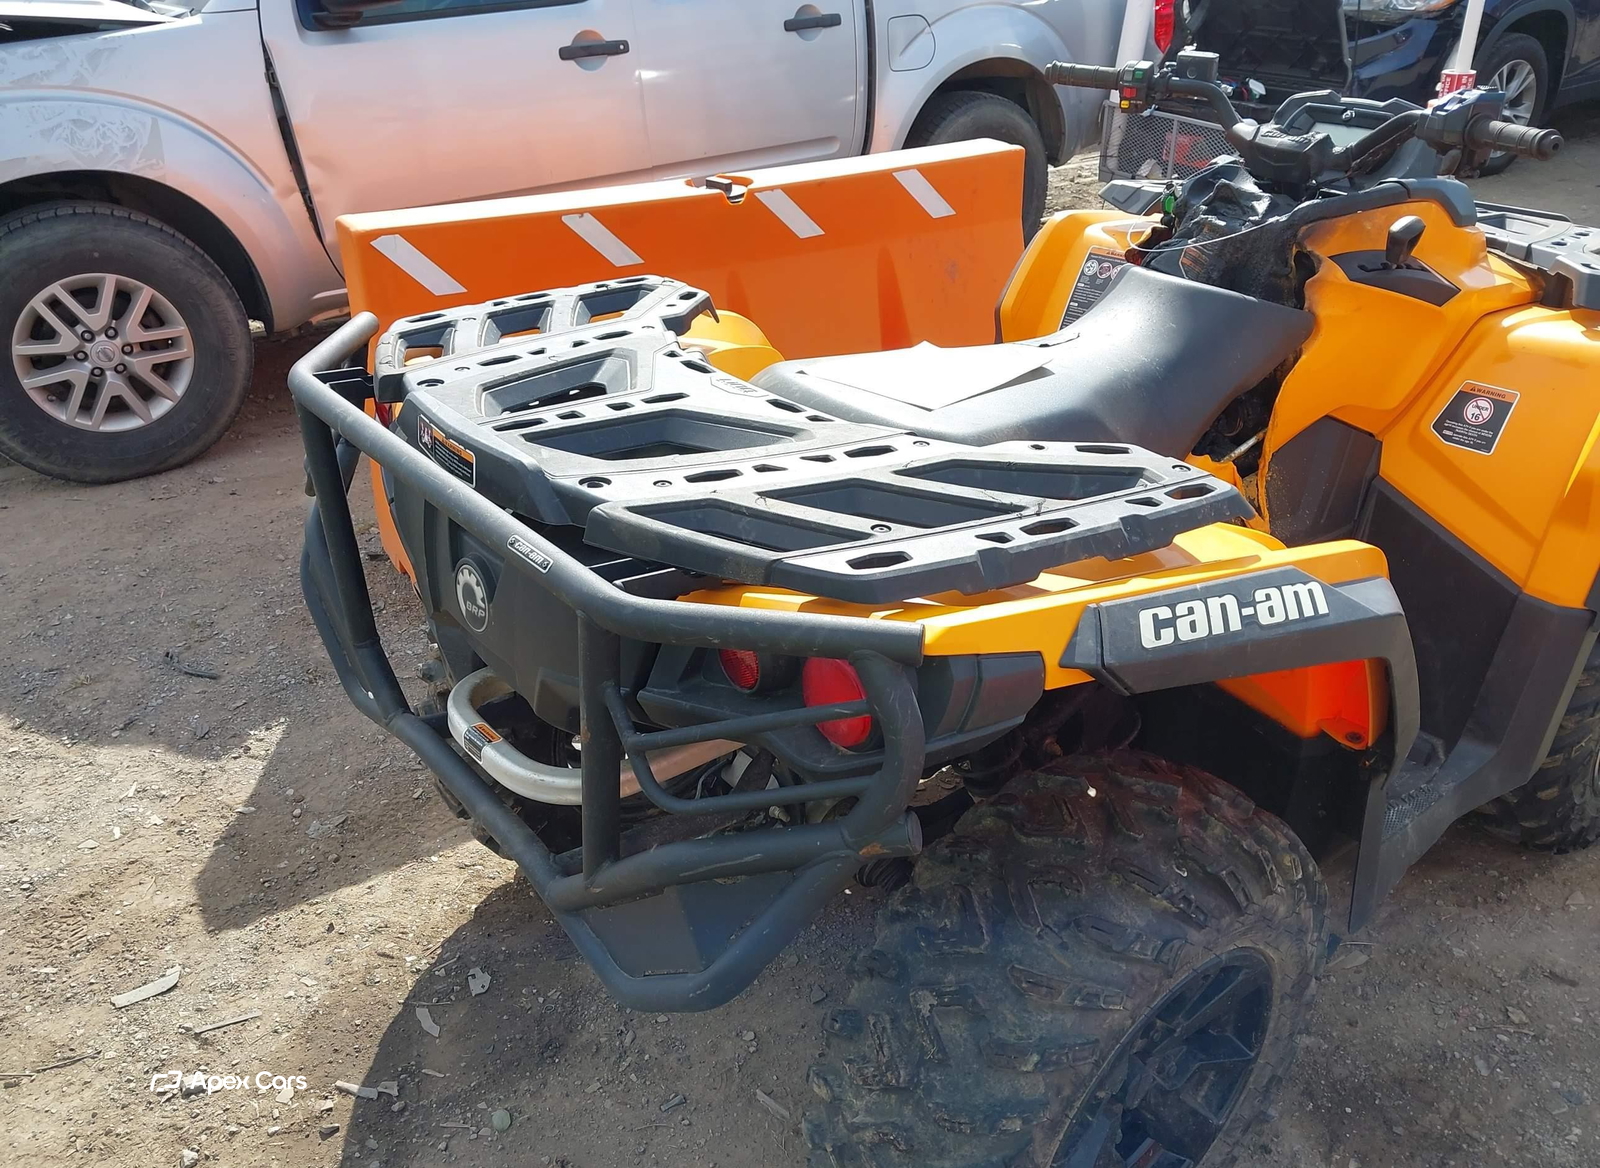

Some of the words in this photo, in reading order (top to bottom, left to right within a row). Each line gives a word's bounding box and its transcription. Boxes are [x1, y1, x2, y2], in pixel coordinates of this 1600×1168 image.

[1477, 387, 1506, 399] WARNING
[1470, 412, 1481, 421] 16
[514, 541, 545, 565] can-am
[466, 600, 486, 618] BRP
[1138, 581, 1330, 649] can-am
